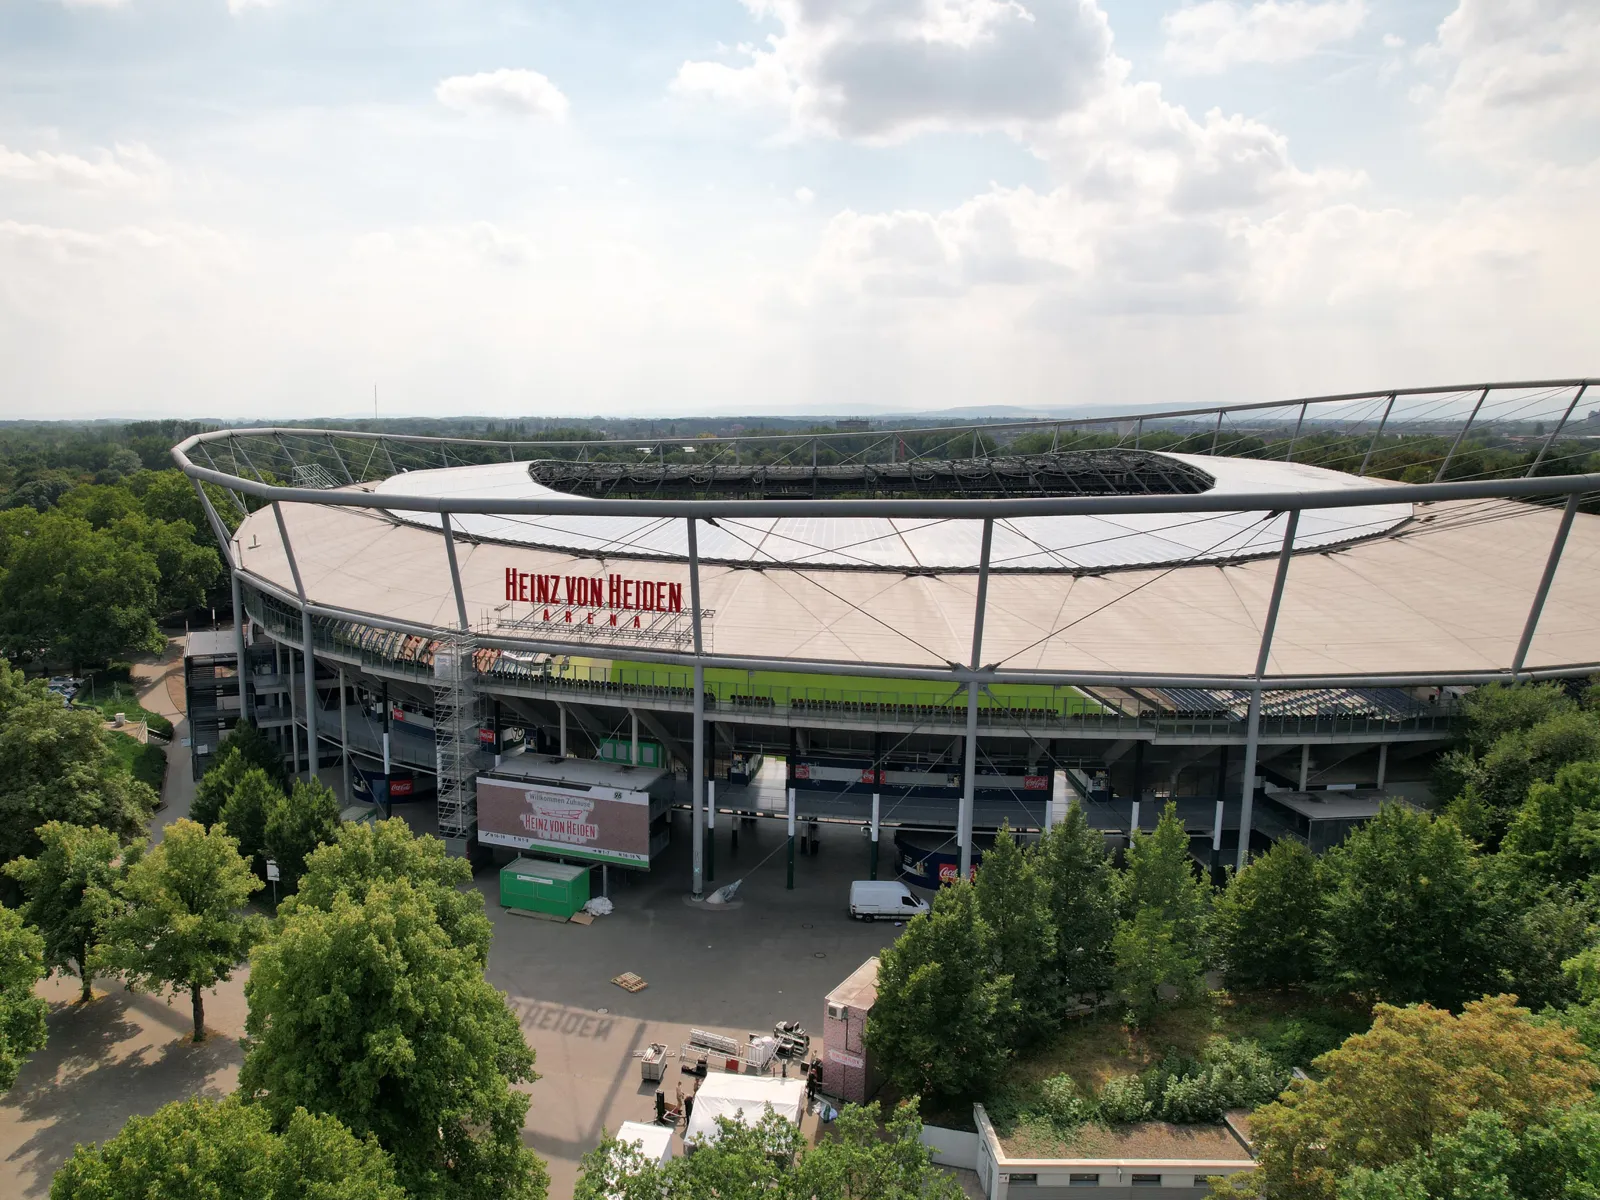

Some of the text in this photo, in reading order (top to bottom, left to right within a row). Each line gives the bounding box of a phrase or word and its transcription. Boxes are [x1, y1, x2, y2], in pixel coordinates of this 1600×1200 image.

[505, 567, 682, 613] HEINZ VON HEIDEN
[543, 608, 640, 628] ARENA
[529, 793, 591, 807] Willkommen Zuhause
[614, 791, 622, 800] 96
[525, 814, 595, 838] HEINZ VON HEIDEN
